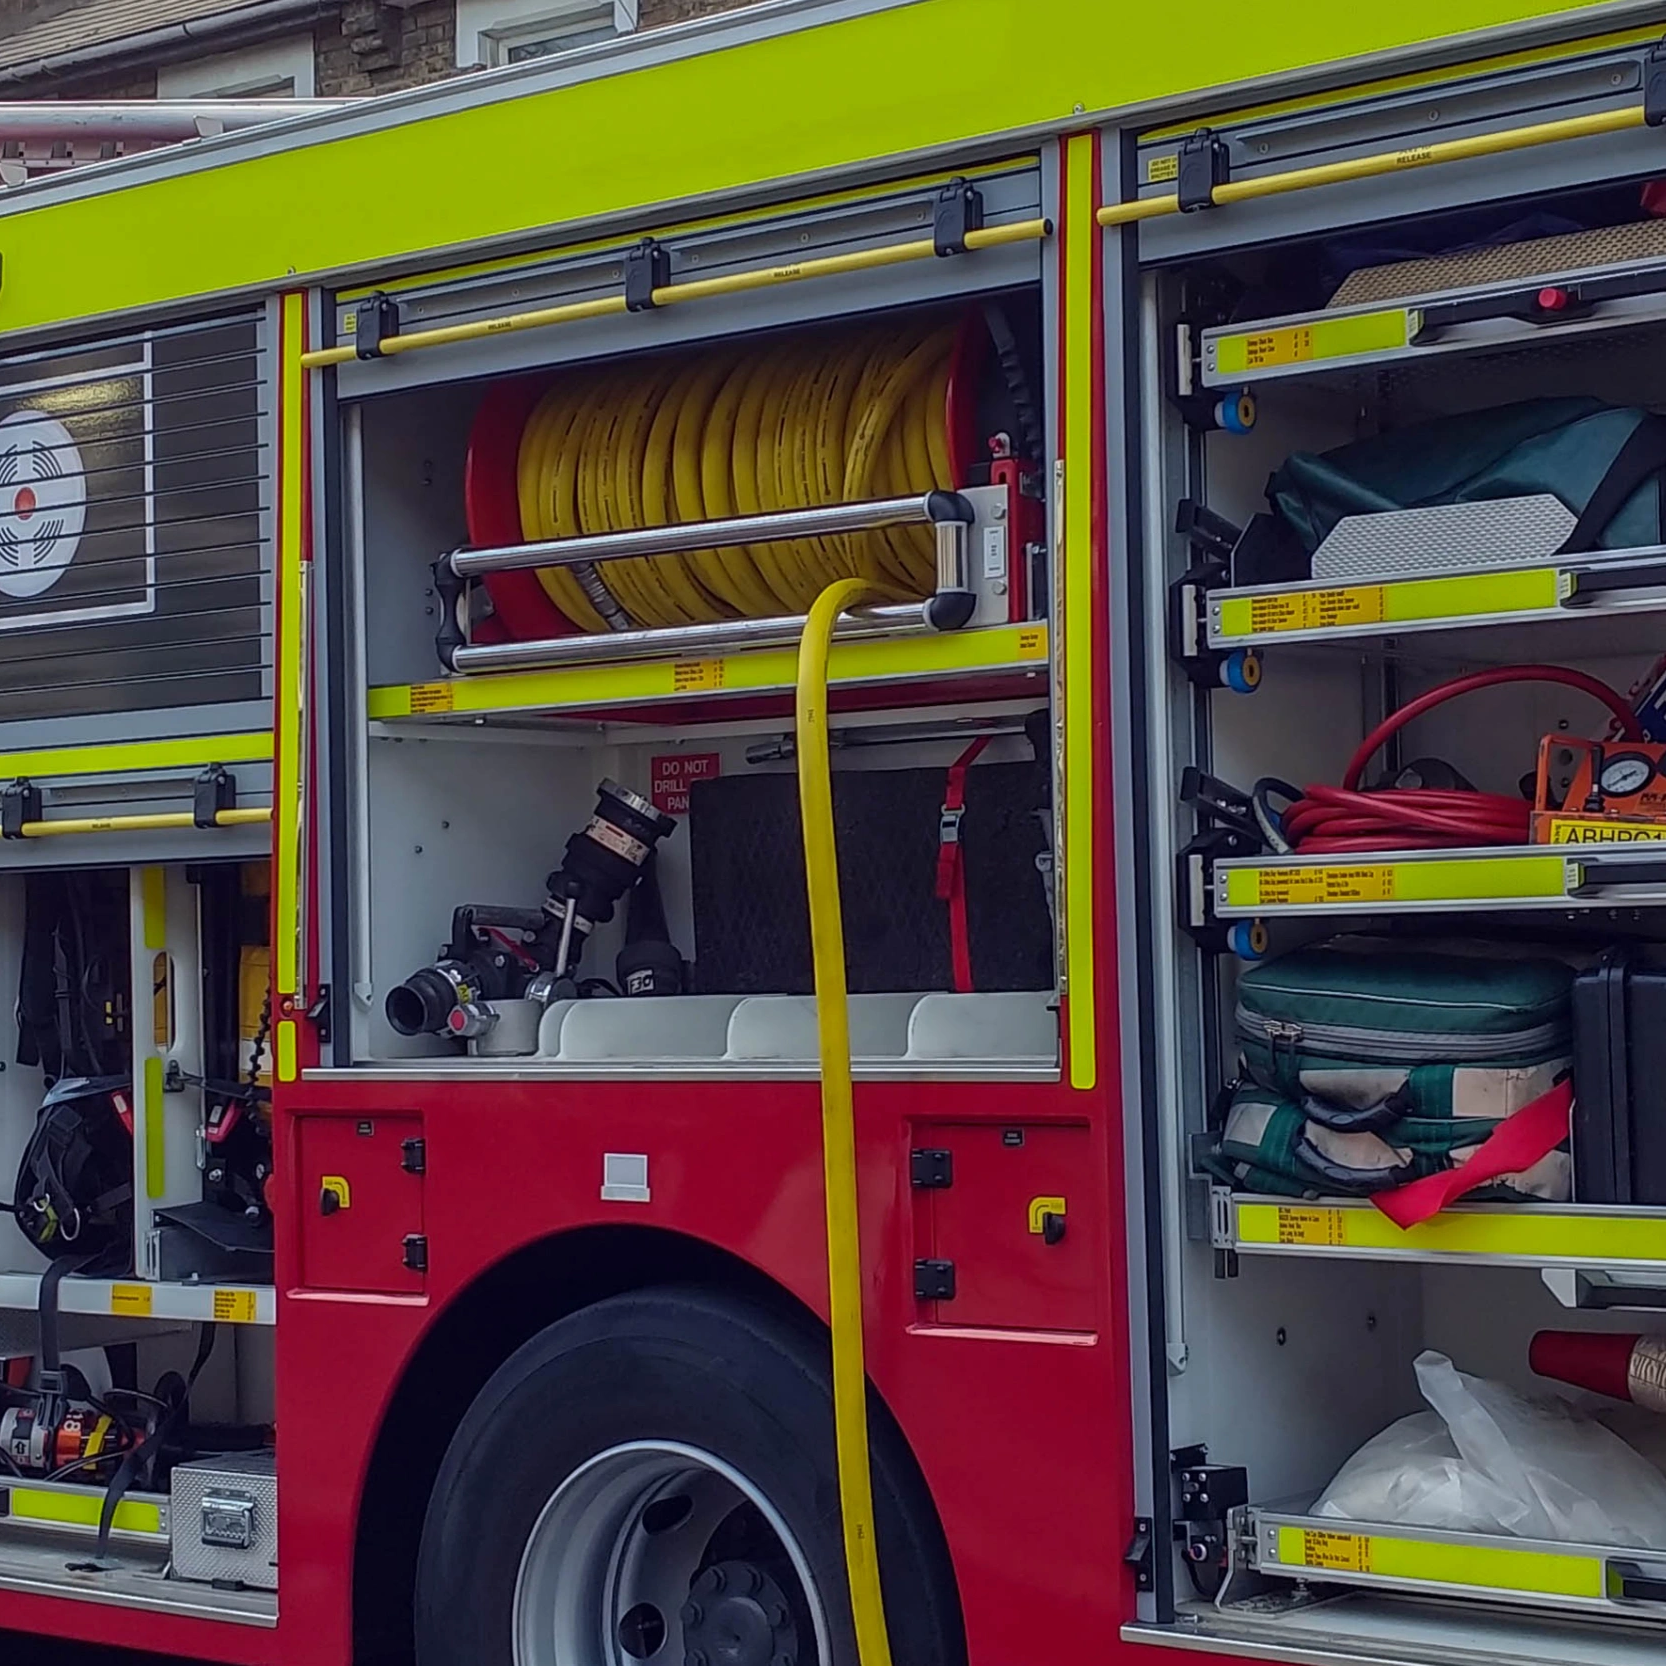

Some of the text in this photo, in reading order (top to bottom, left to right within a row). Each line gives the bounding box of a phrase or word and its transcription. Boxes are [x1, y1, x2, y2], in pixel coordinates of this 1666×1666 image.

[1396, 151, 1432, 164] RELEASE
[662, 759, 709, 776] DO NOT
[654, 779, 687, 794] DRILL
